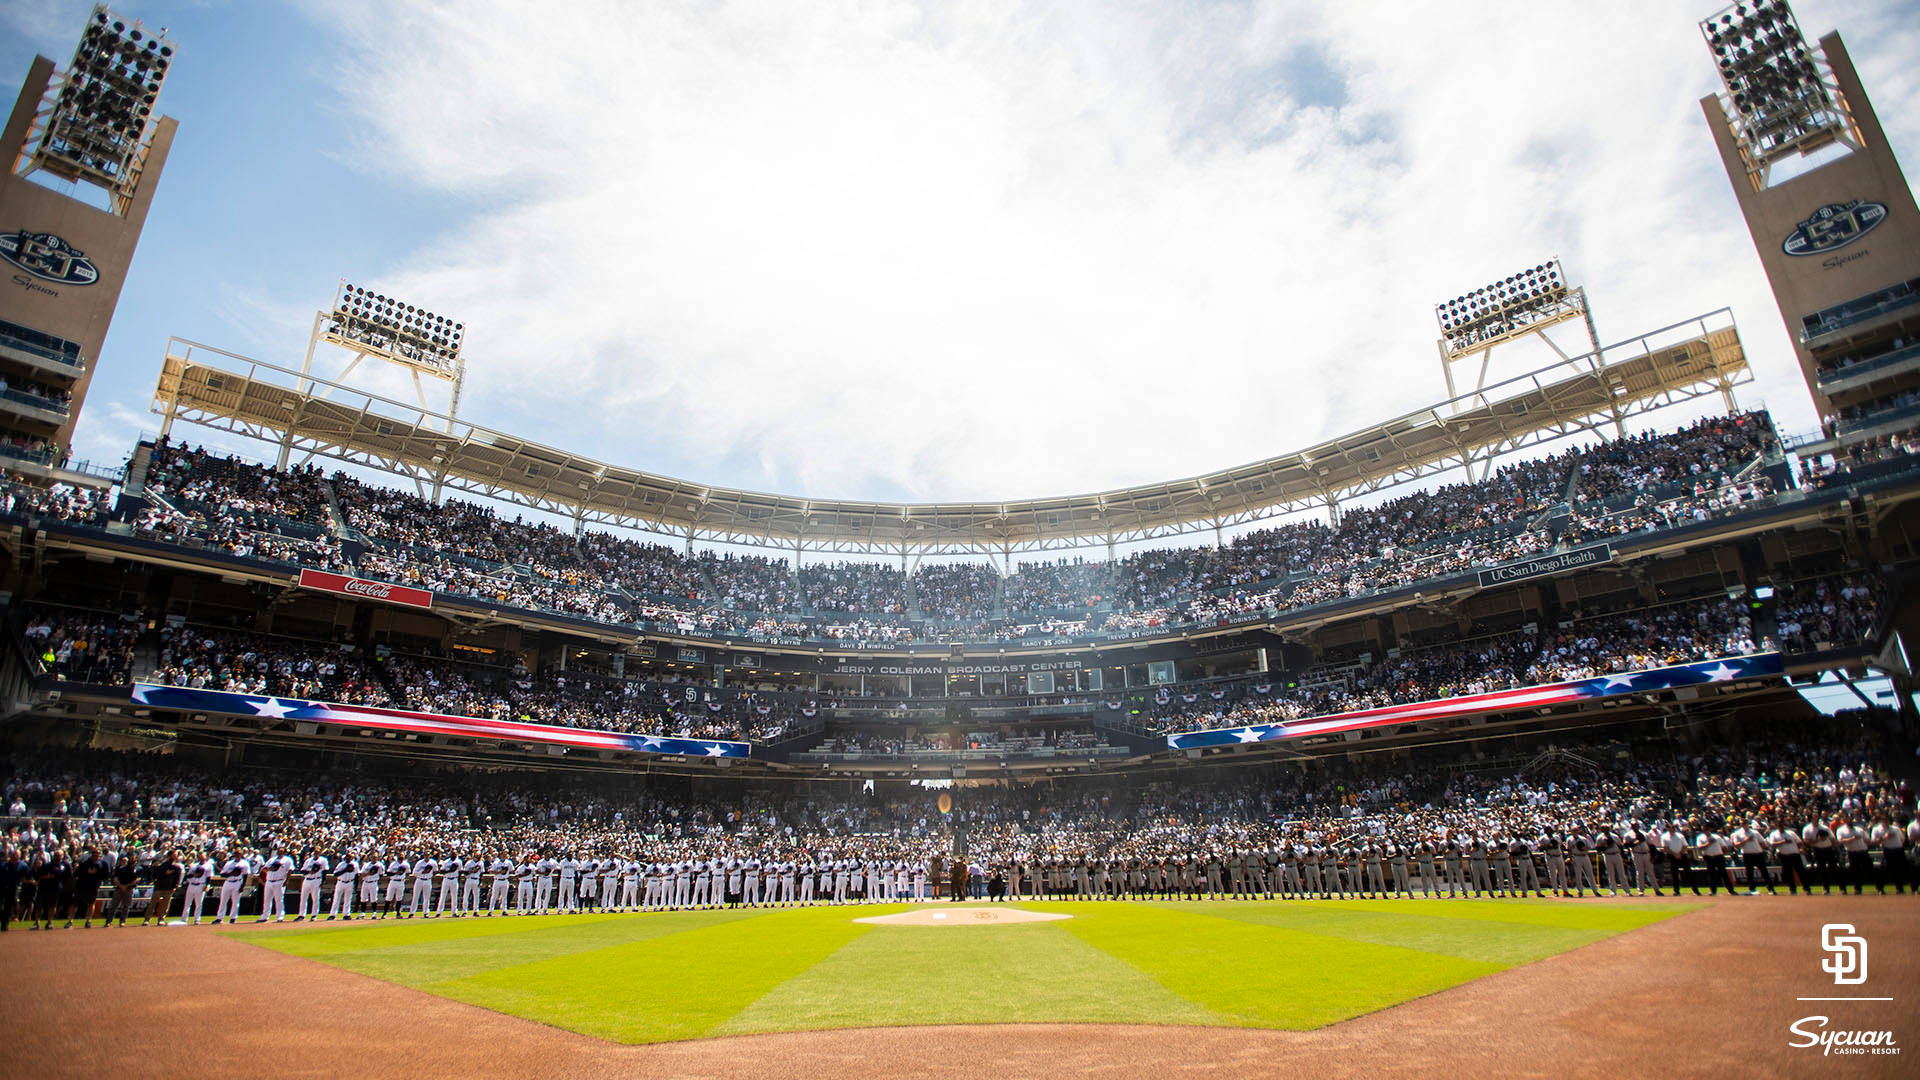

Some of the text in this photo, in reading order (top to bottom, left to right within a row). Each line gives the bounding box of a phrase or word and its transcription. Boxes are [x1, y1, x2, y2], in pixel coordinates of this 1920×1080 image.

[1822, 248, 1870, 271] Sycuan
[11, 274, 60, 297] Sycuan
[1491, 551, 1596, 582] UC San Diego Health
[344, 579, 393, 598] Coca-Cola
[1230, 614, 1261, 624] ROBINSON
[657, 626, 677, 634] STEVE
[1107, 632, 1129, 640] TREVOR
[1141, 628, 1170, 637] HOFFMAN
[770, 637, 778, 645] 19
[880, 666, 942, 674] COLEMAN
[947, 664, 1026, 674] BROADCAST
[1031, 660, 1083, 671] CENTER
[685, 687, 697, 703] SD
